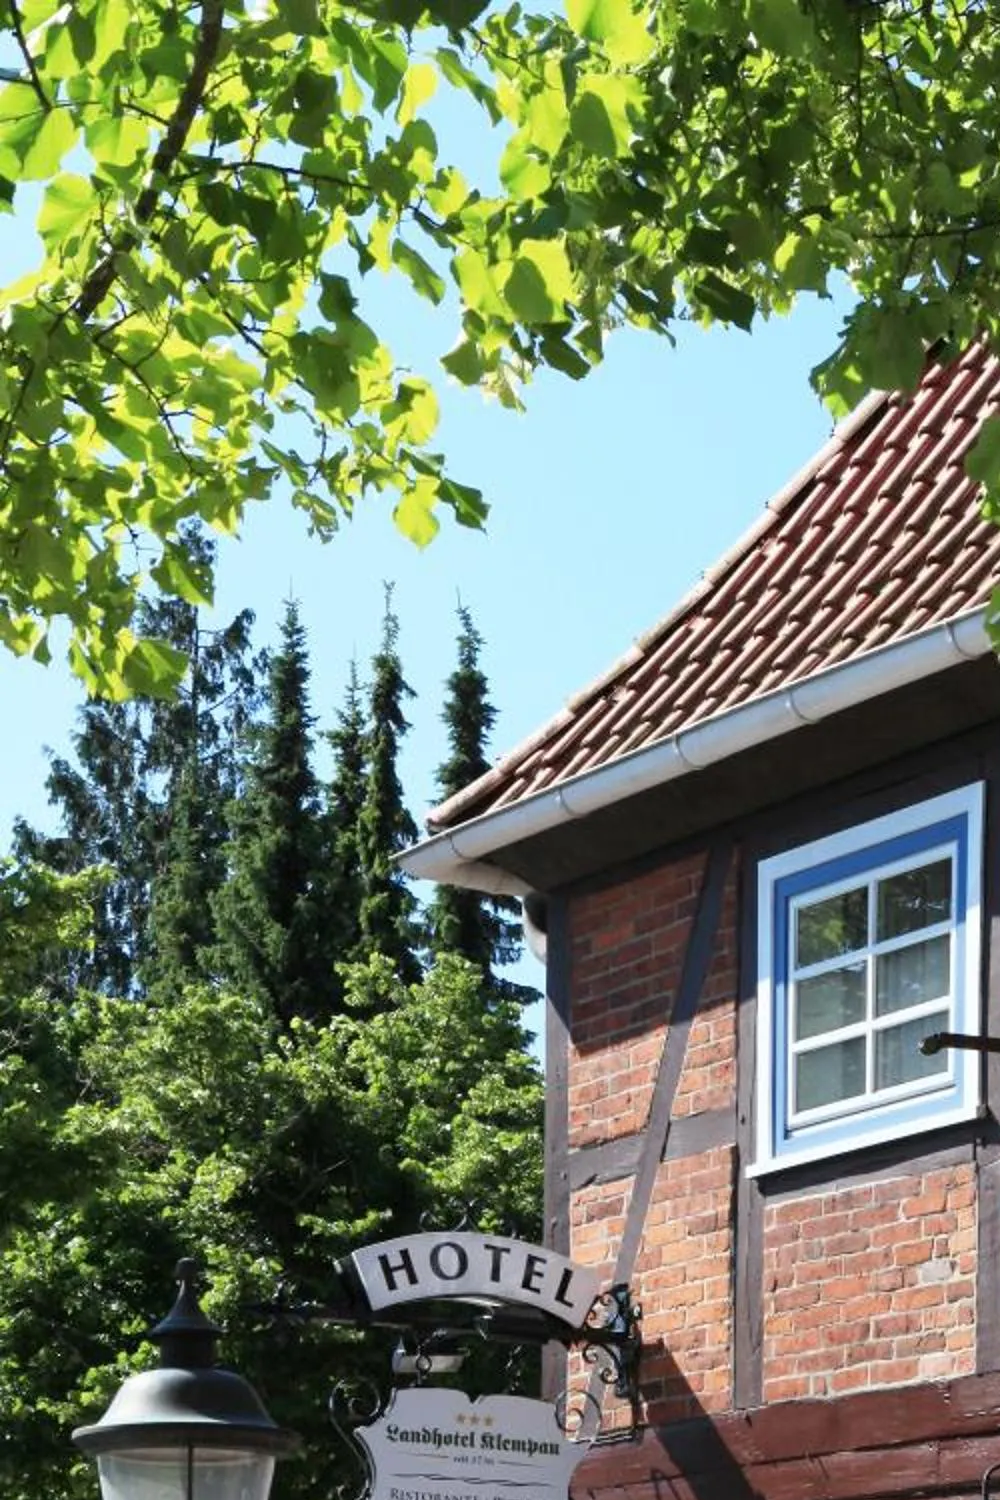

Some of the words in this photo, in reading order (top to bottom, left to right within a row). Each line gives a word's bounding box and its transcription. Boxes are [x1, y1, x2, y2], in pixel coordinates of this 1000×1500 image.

[378, 1241, 578, 1309] HOTEL
[386, 1423, 476, 1449] Landhotel
[480, 1431, 560, 1457] Klempau
